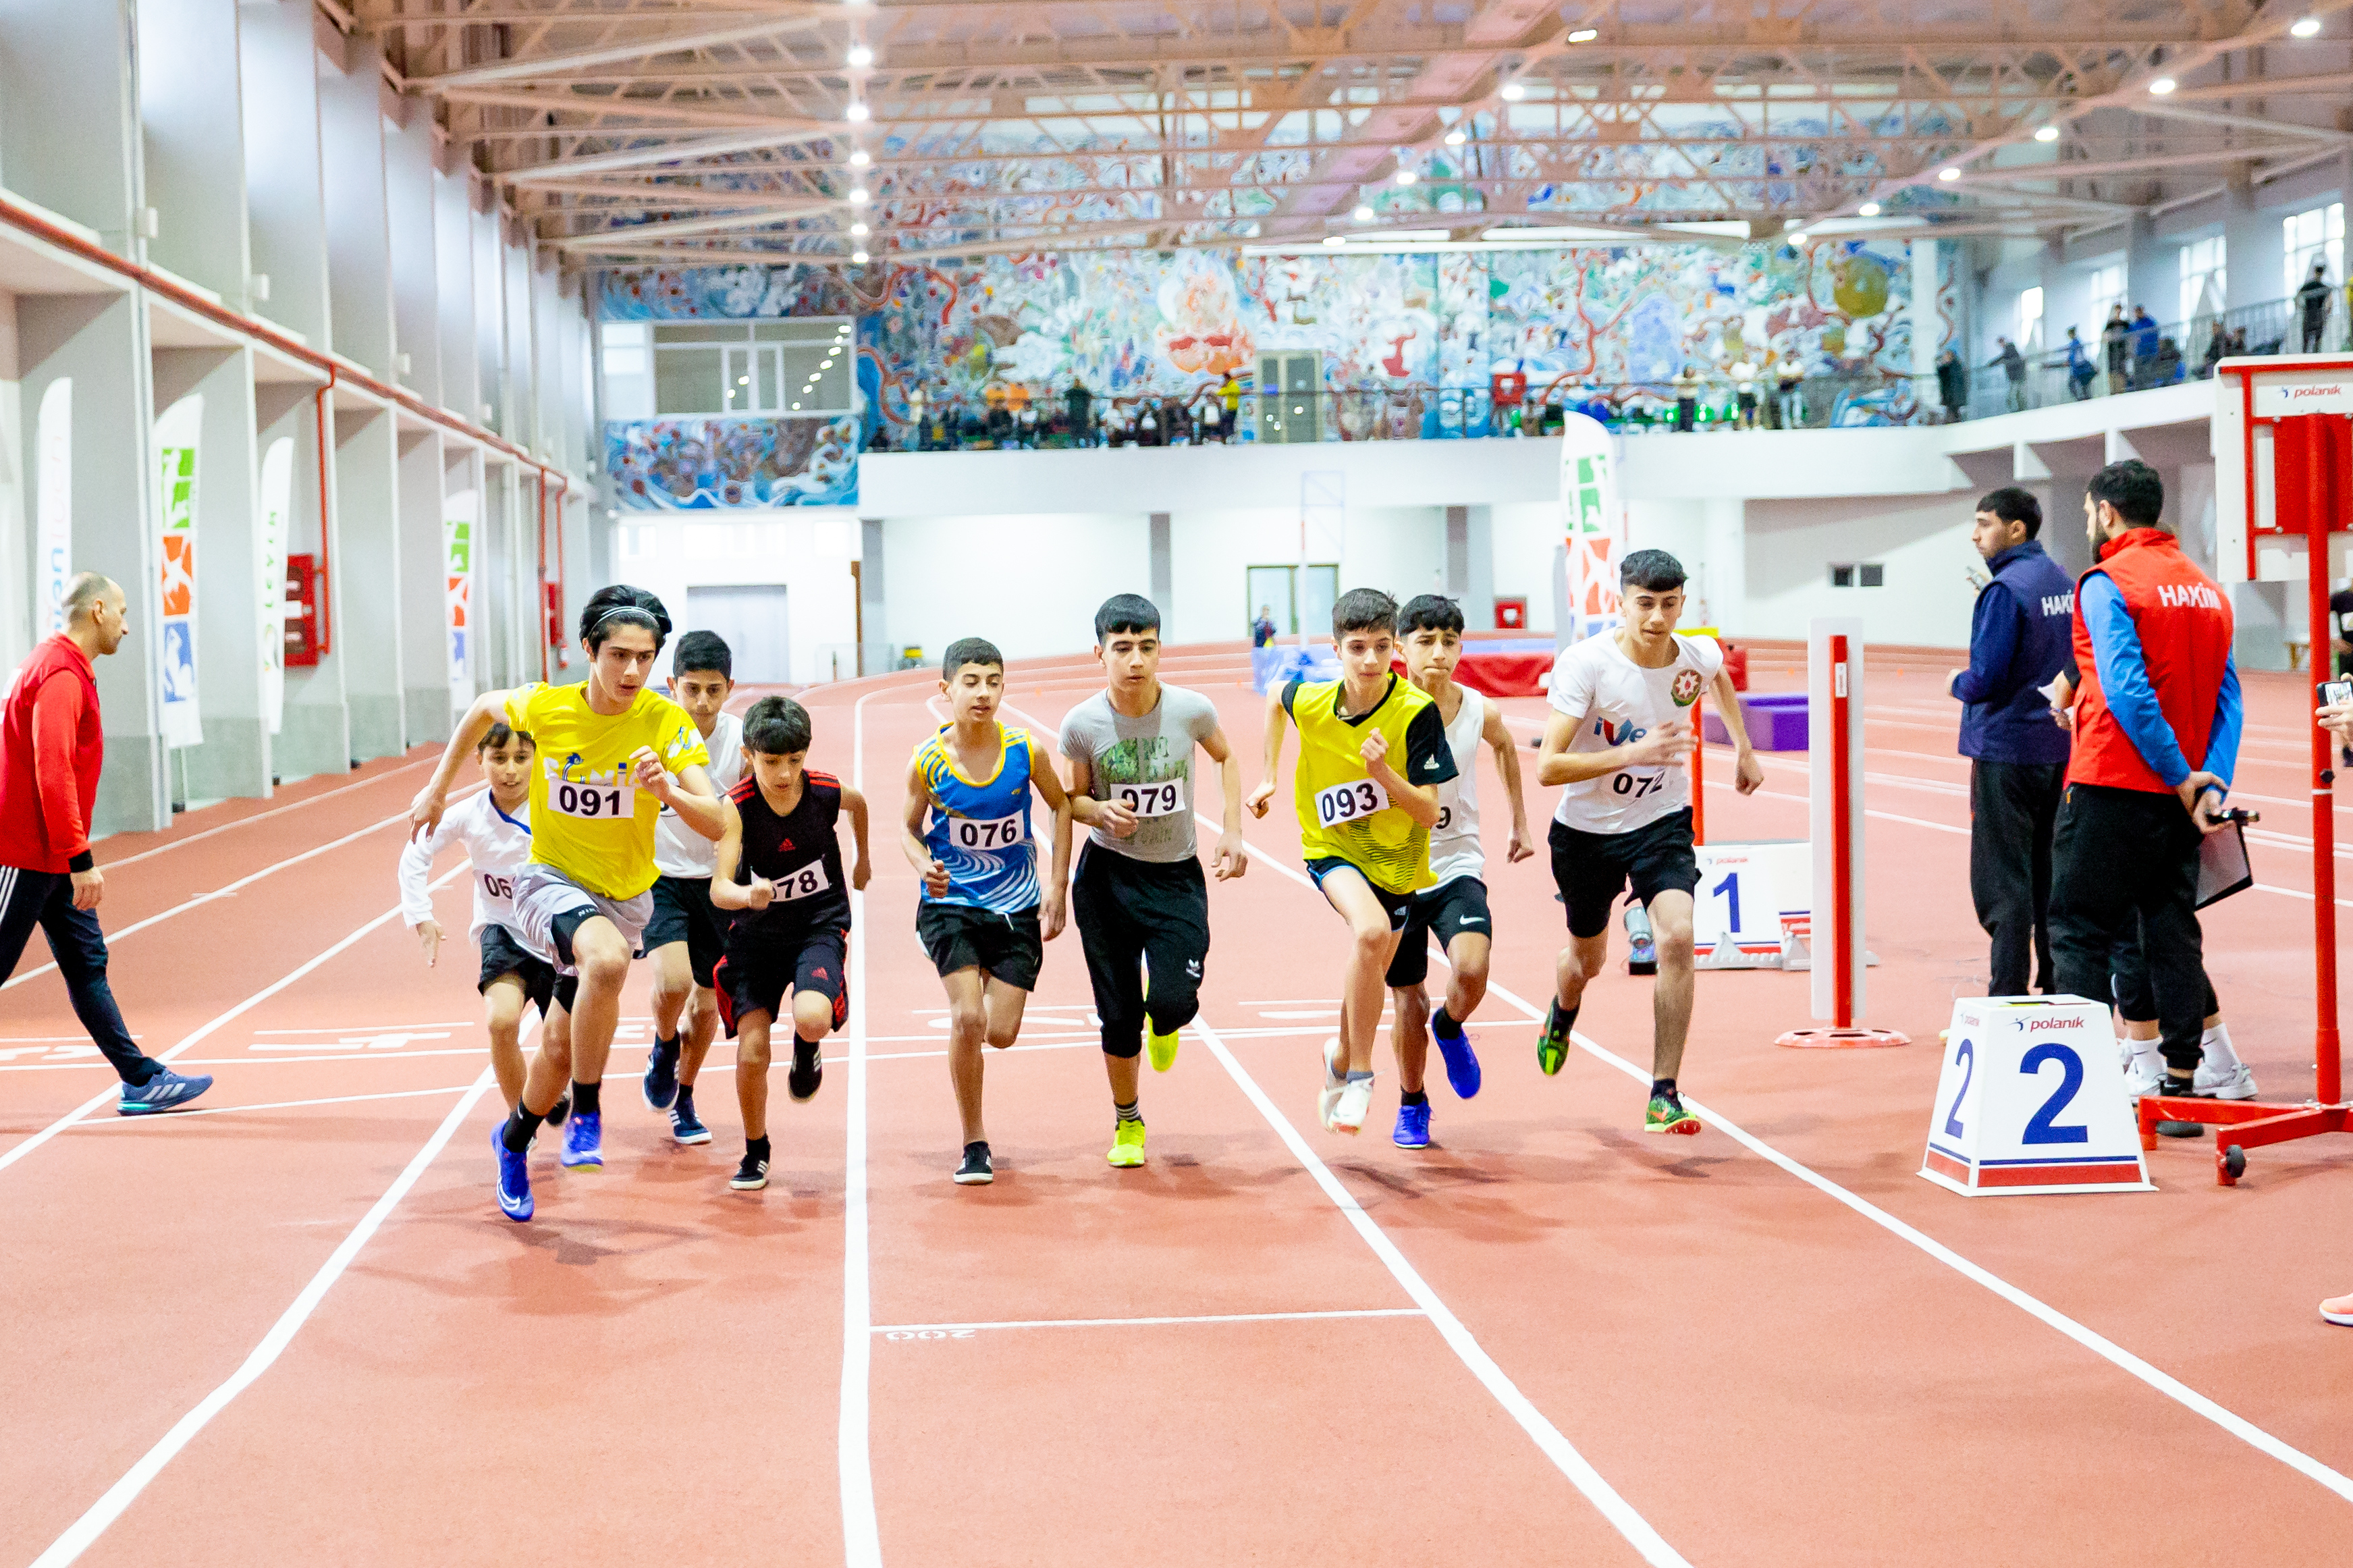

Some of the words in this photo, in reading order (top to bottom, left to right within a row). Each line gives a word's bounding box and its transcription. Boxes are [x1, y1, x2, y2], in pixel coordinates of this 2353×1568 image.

[559, 785, 620, 816] 091
[1121, 784, 1176, 814] 079
[1613, 772, 1665, 799] 072
[1322, 783, 1378, 822] 093
[961, 819, 1017, 847] 076
[772, 870, 818, 899] 78
[1712, 872, 1741, 933] 1
[2030, 1016, 2085, 1033] polanik
[1945, 1038, 1974, 1139] 2
[2020, 1043, 2088, 1145] 2
